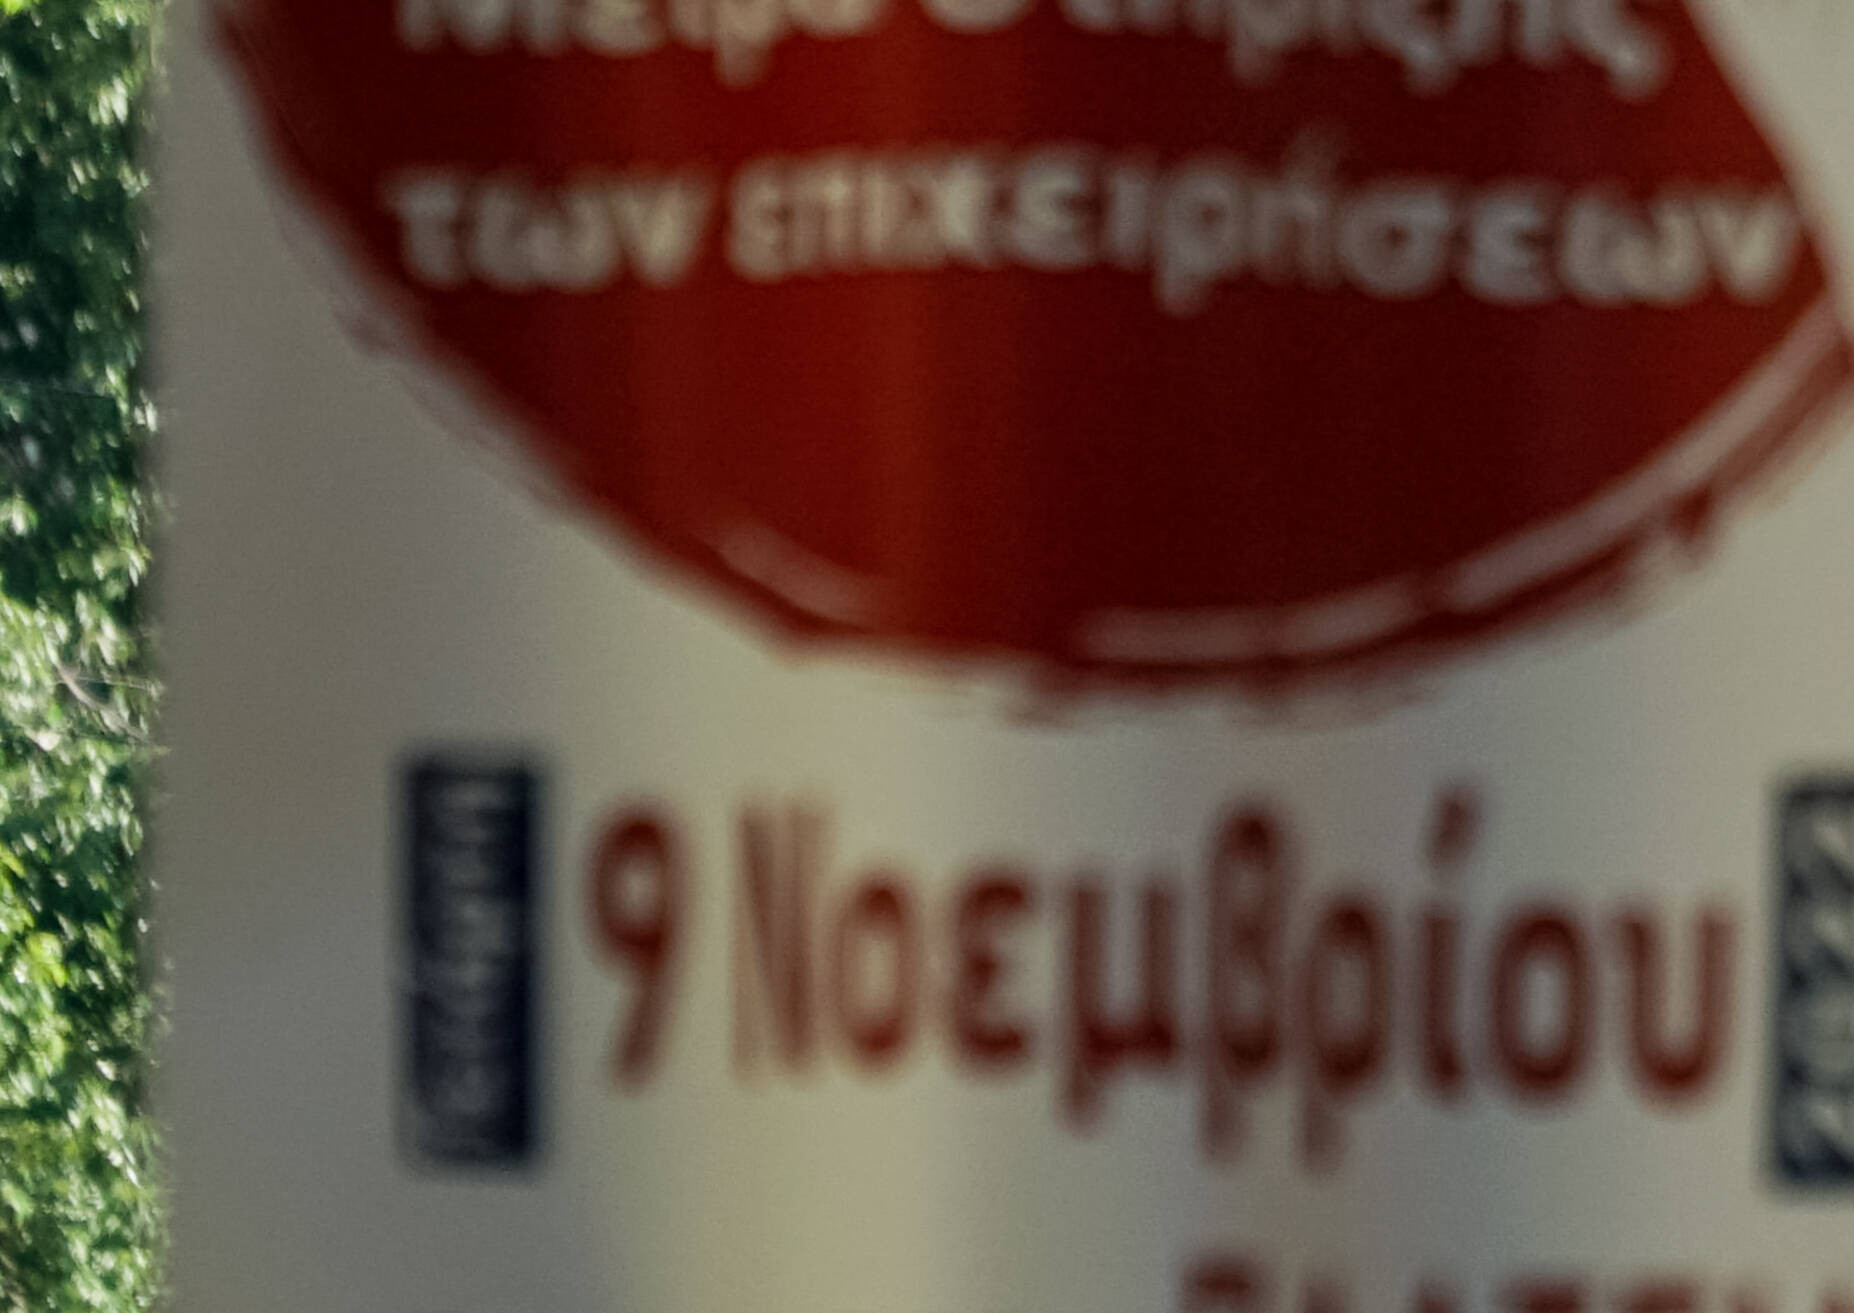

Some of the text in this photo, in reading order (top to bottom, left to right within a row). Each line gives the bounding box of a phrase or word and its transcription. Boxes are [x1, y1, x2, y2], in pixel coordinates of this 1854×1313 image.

[384, 122, 1805, 318] των επιχειρήσεων
[585, 806, 689, 1088] 9
[731, 782, 1743, 1167] Νοεμβρίου
